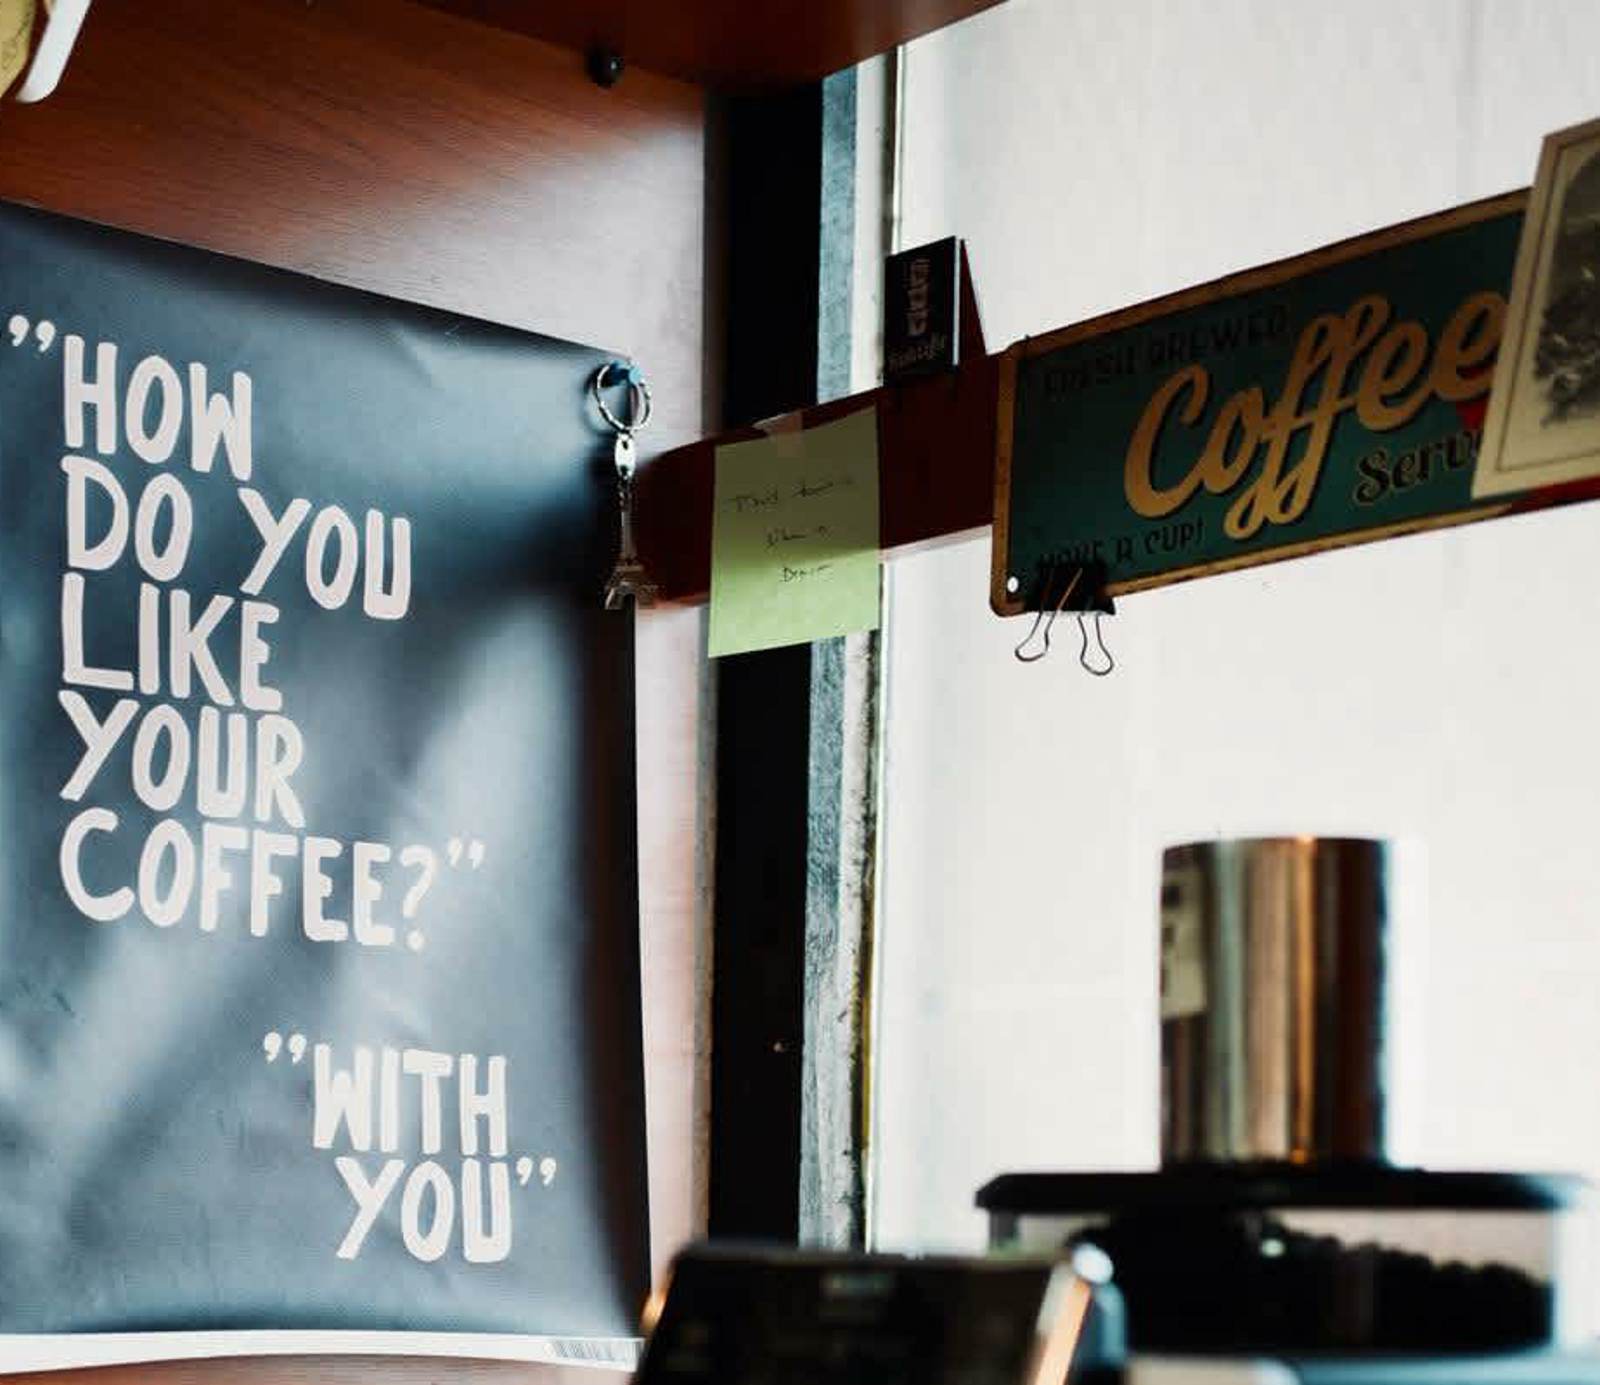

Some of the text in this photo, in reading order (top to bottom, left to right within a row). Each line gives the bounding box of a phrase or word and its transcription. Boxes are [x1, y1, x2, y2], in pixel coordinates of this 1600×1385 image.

[8, 313, 253, 481] ”HOW
[1123, 290, 1509, 540] Coffee
[1352, 427, 1481, 506] Serv
[60, 455, 412, 620] DO YOU
[61, 572, 284, 712] LIKE
[58, 689, 306, 828] YOUR
[59, 806, 486, 953] COFFEE?”
[263, 1030, 507, 1157] ”WITH
[333, 1155, 557, 1264] YOU”
